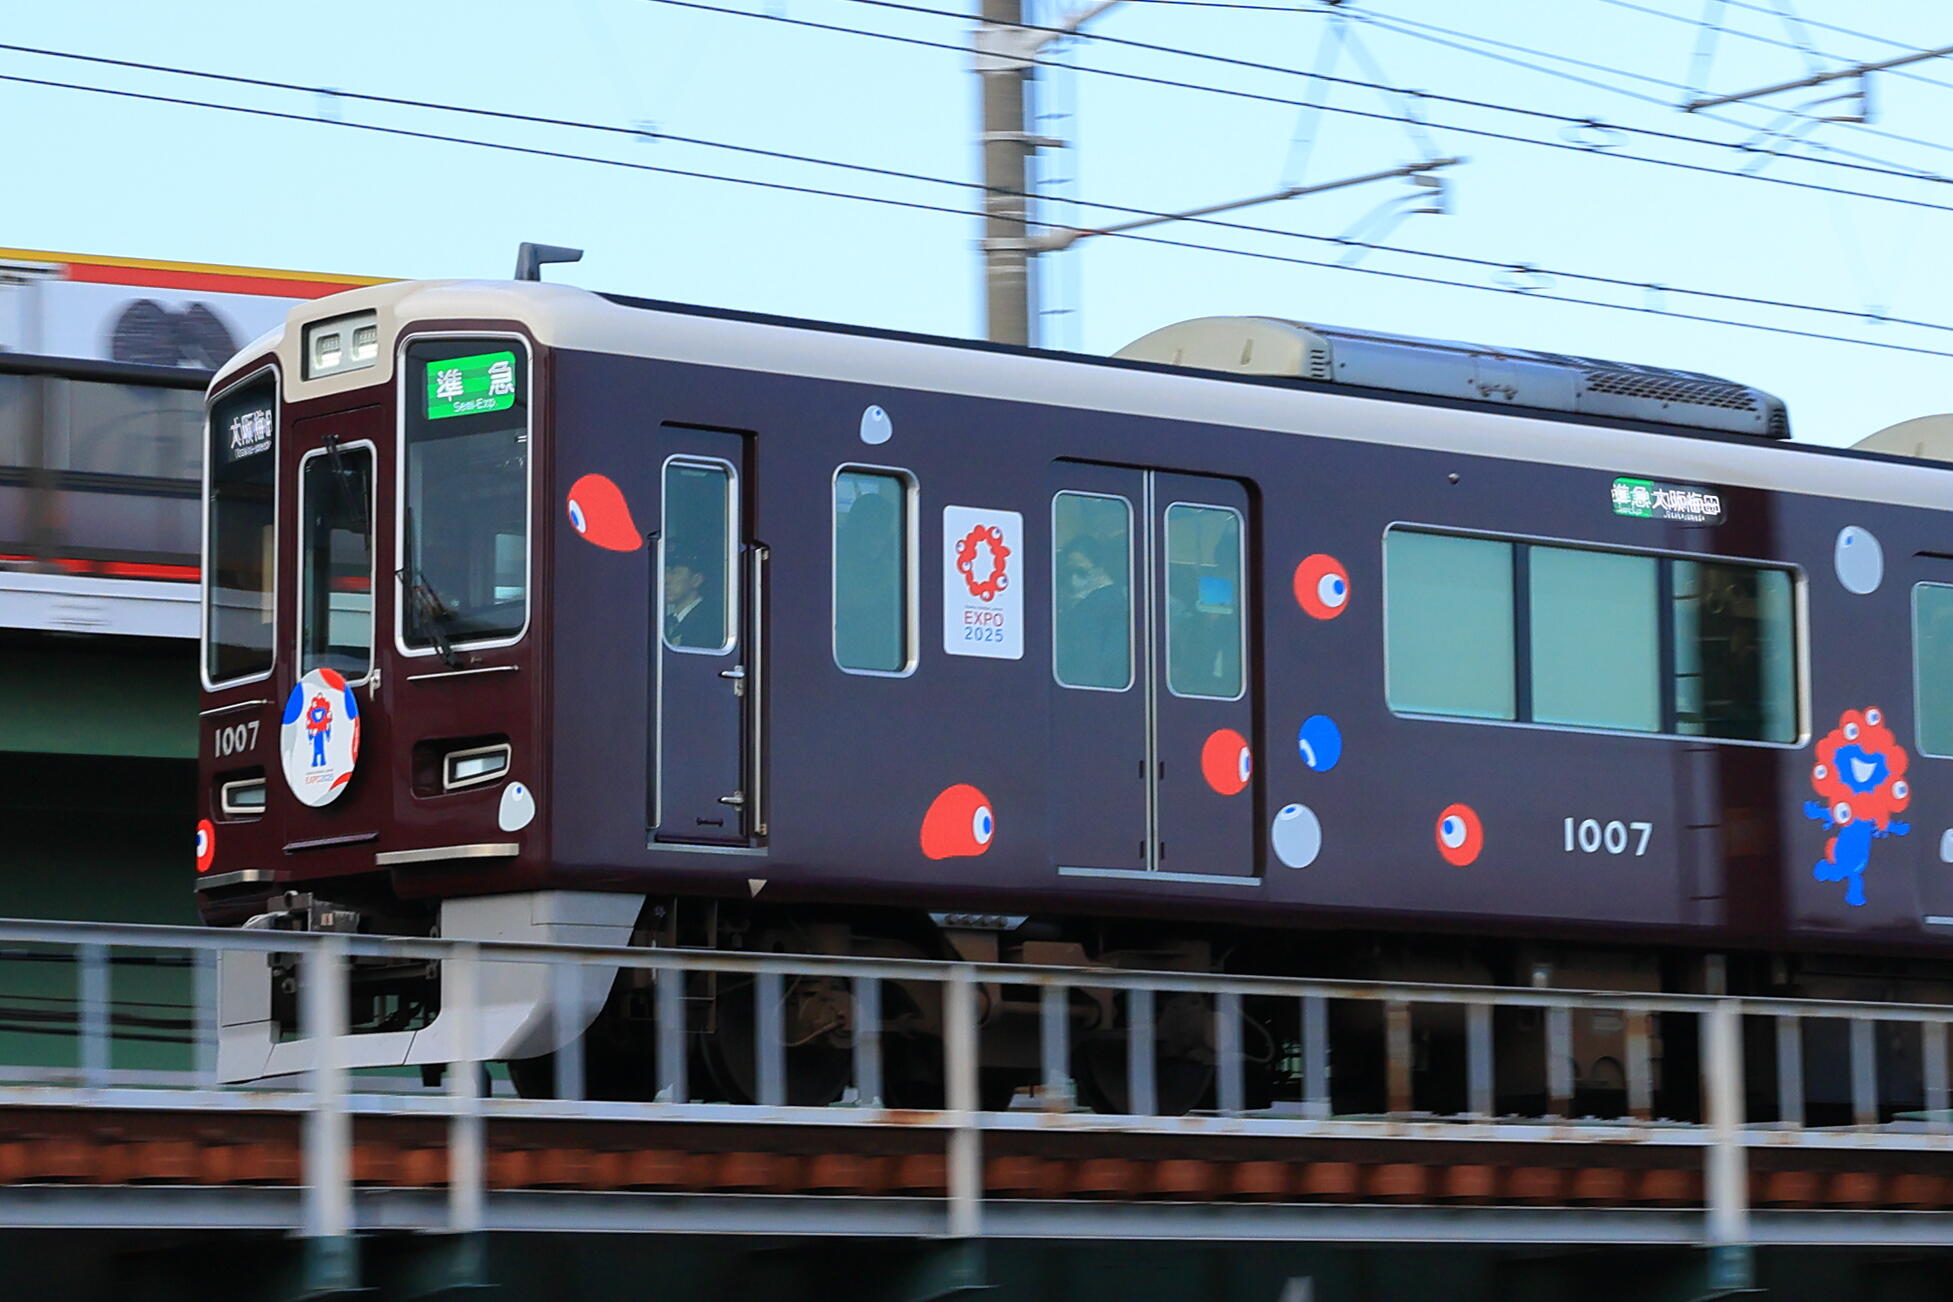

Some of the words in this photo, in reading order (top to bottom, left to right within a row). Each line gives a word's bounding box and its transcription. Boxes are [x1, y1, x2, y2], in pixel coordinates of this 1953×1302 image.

[963, 610, 1004, 627] EXPO
[964, 626, 1004, 643] 2025
[214, 720, 260, 758] 1007
[1564, 817, 1653, 856] 1007
